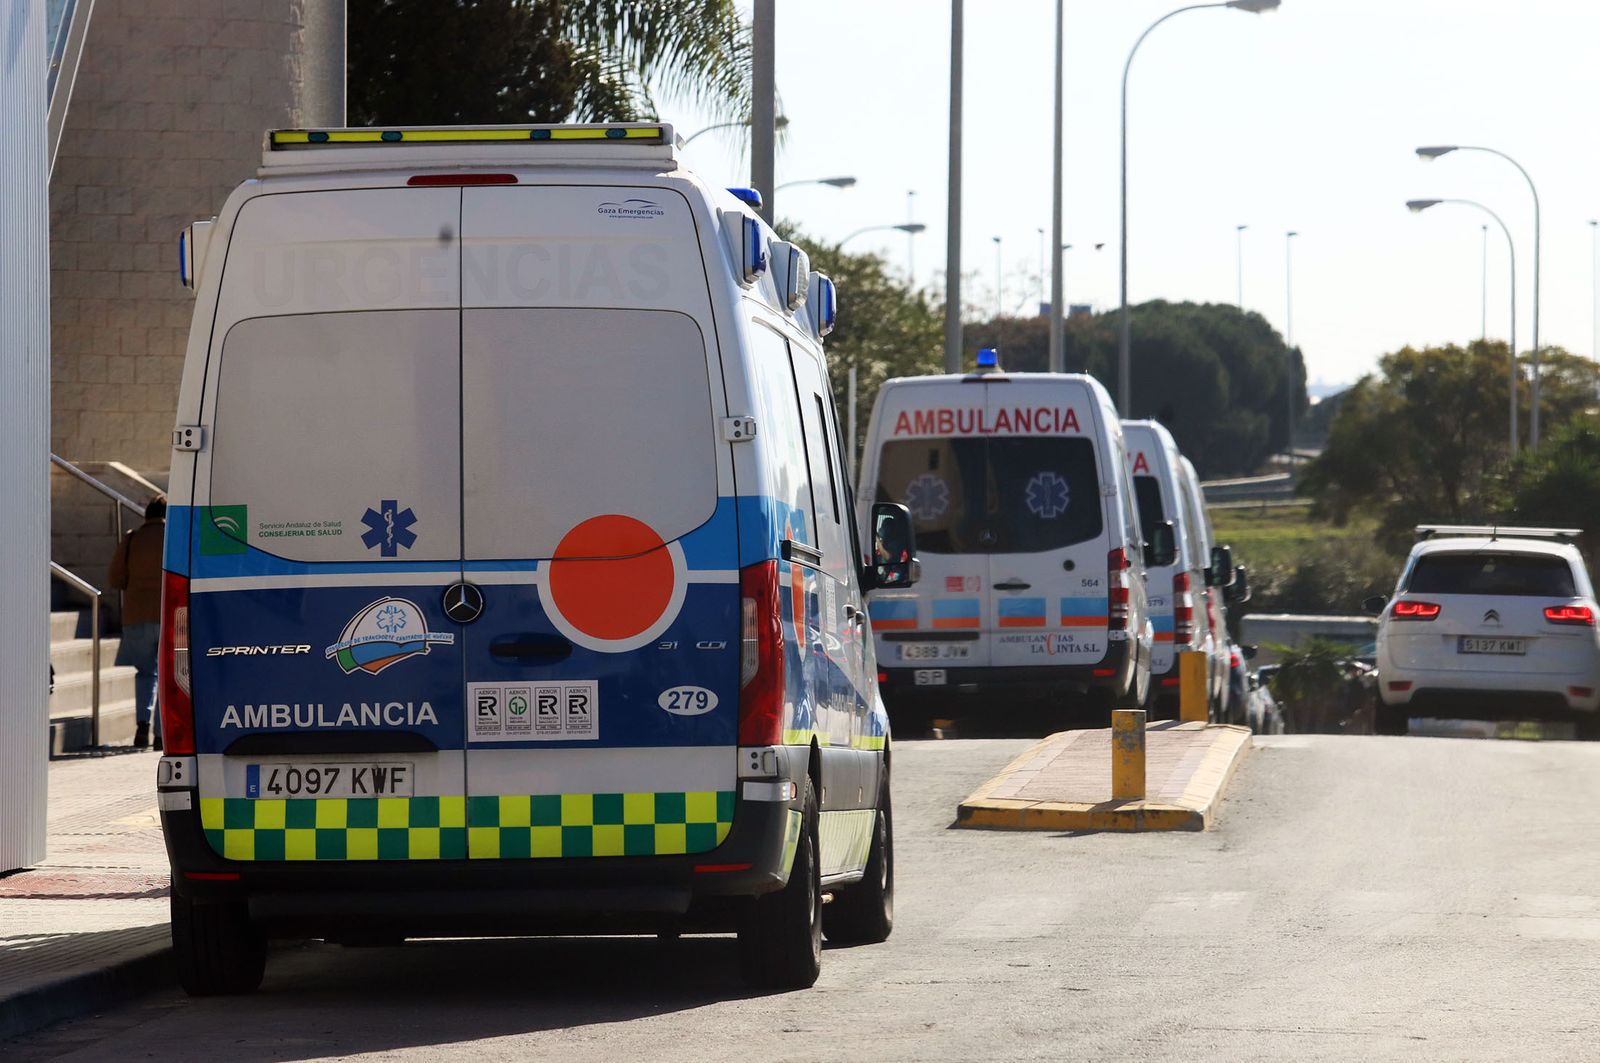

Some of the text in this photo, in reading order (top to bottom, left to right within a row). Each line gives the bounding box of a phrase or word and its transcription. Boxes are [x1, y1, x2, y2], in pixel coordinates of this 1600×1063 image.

[618, 207, 665, 216] Emergencias
[249, 243, 672, 307] URGENCIAS
[894, 408, 1081, 435] AMBULANCIA
[259, 522, 284, 530] Servicio
[286, 521, 311, 529] Andaluz
[323, 520, 342, 528] Salud
[258, 530, 304, 538] CONSEJERIA
[1081, 579, 1099, 588] 564
[206, 644, 311, 657] SPRINTER
[696, 641, 728, 650] CDI
[1031, 644, 1045, 654] LA
[1083, 643, 1100, 653] S.L.
[1465, 639, 1521, 651] 5137 KMT
[919, 671, 942, 684] SP
[667, 690, 709, 710] 279
[220, 702, 439, 729] AMBULANCIA
[250, 767, 407, 795] E 4097 KWF
